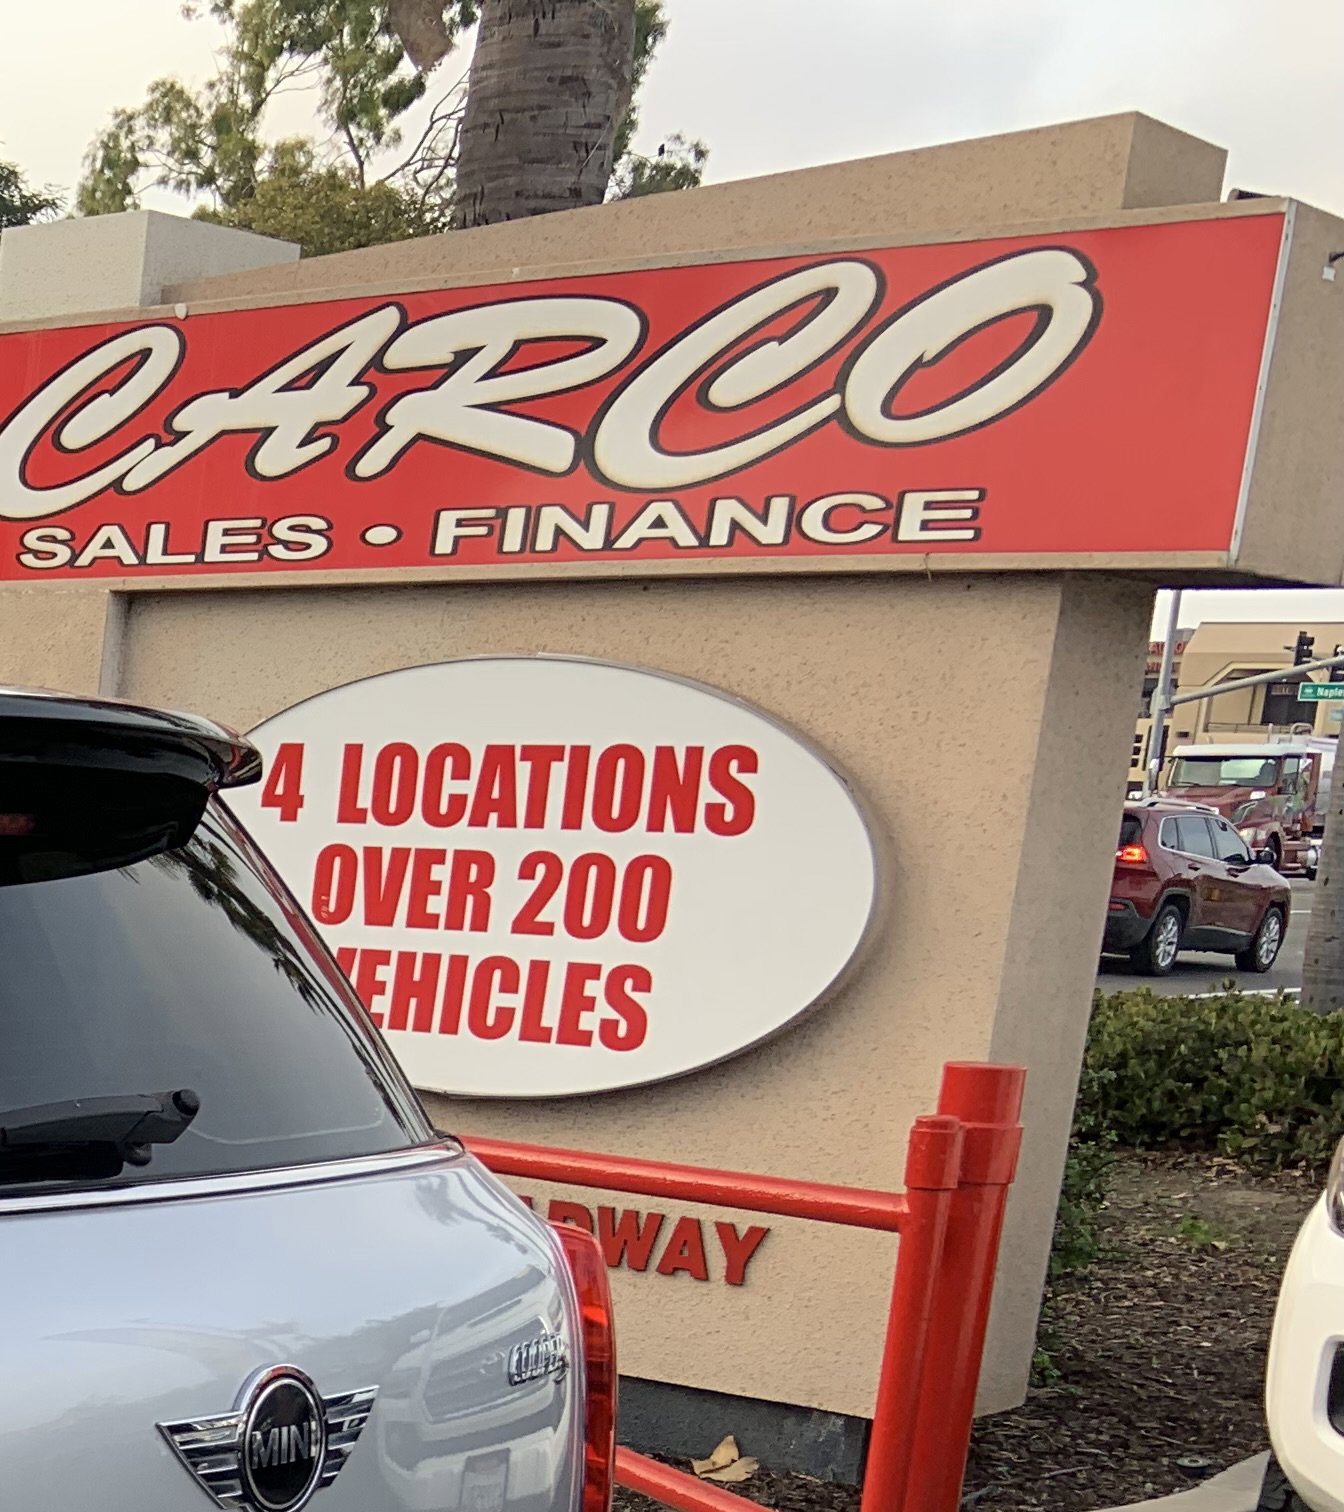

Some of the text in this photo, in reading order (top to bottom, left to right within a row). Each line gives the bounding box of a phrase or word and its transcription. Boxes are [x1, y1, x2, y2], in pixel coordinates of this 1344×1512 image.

[18, 487, 984, 569] SALES FINANCE
[1317, 687, 1344, 698] Naple
[261, 742, 759, 837] 4 LOCATIONS
[312, 843, 673, 943] OVER 200
[252, 1421, 316, 1469] MINI
